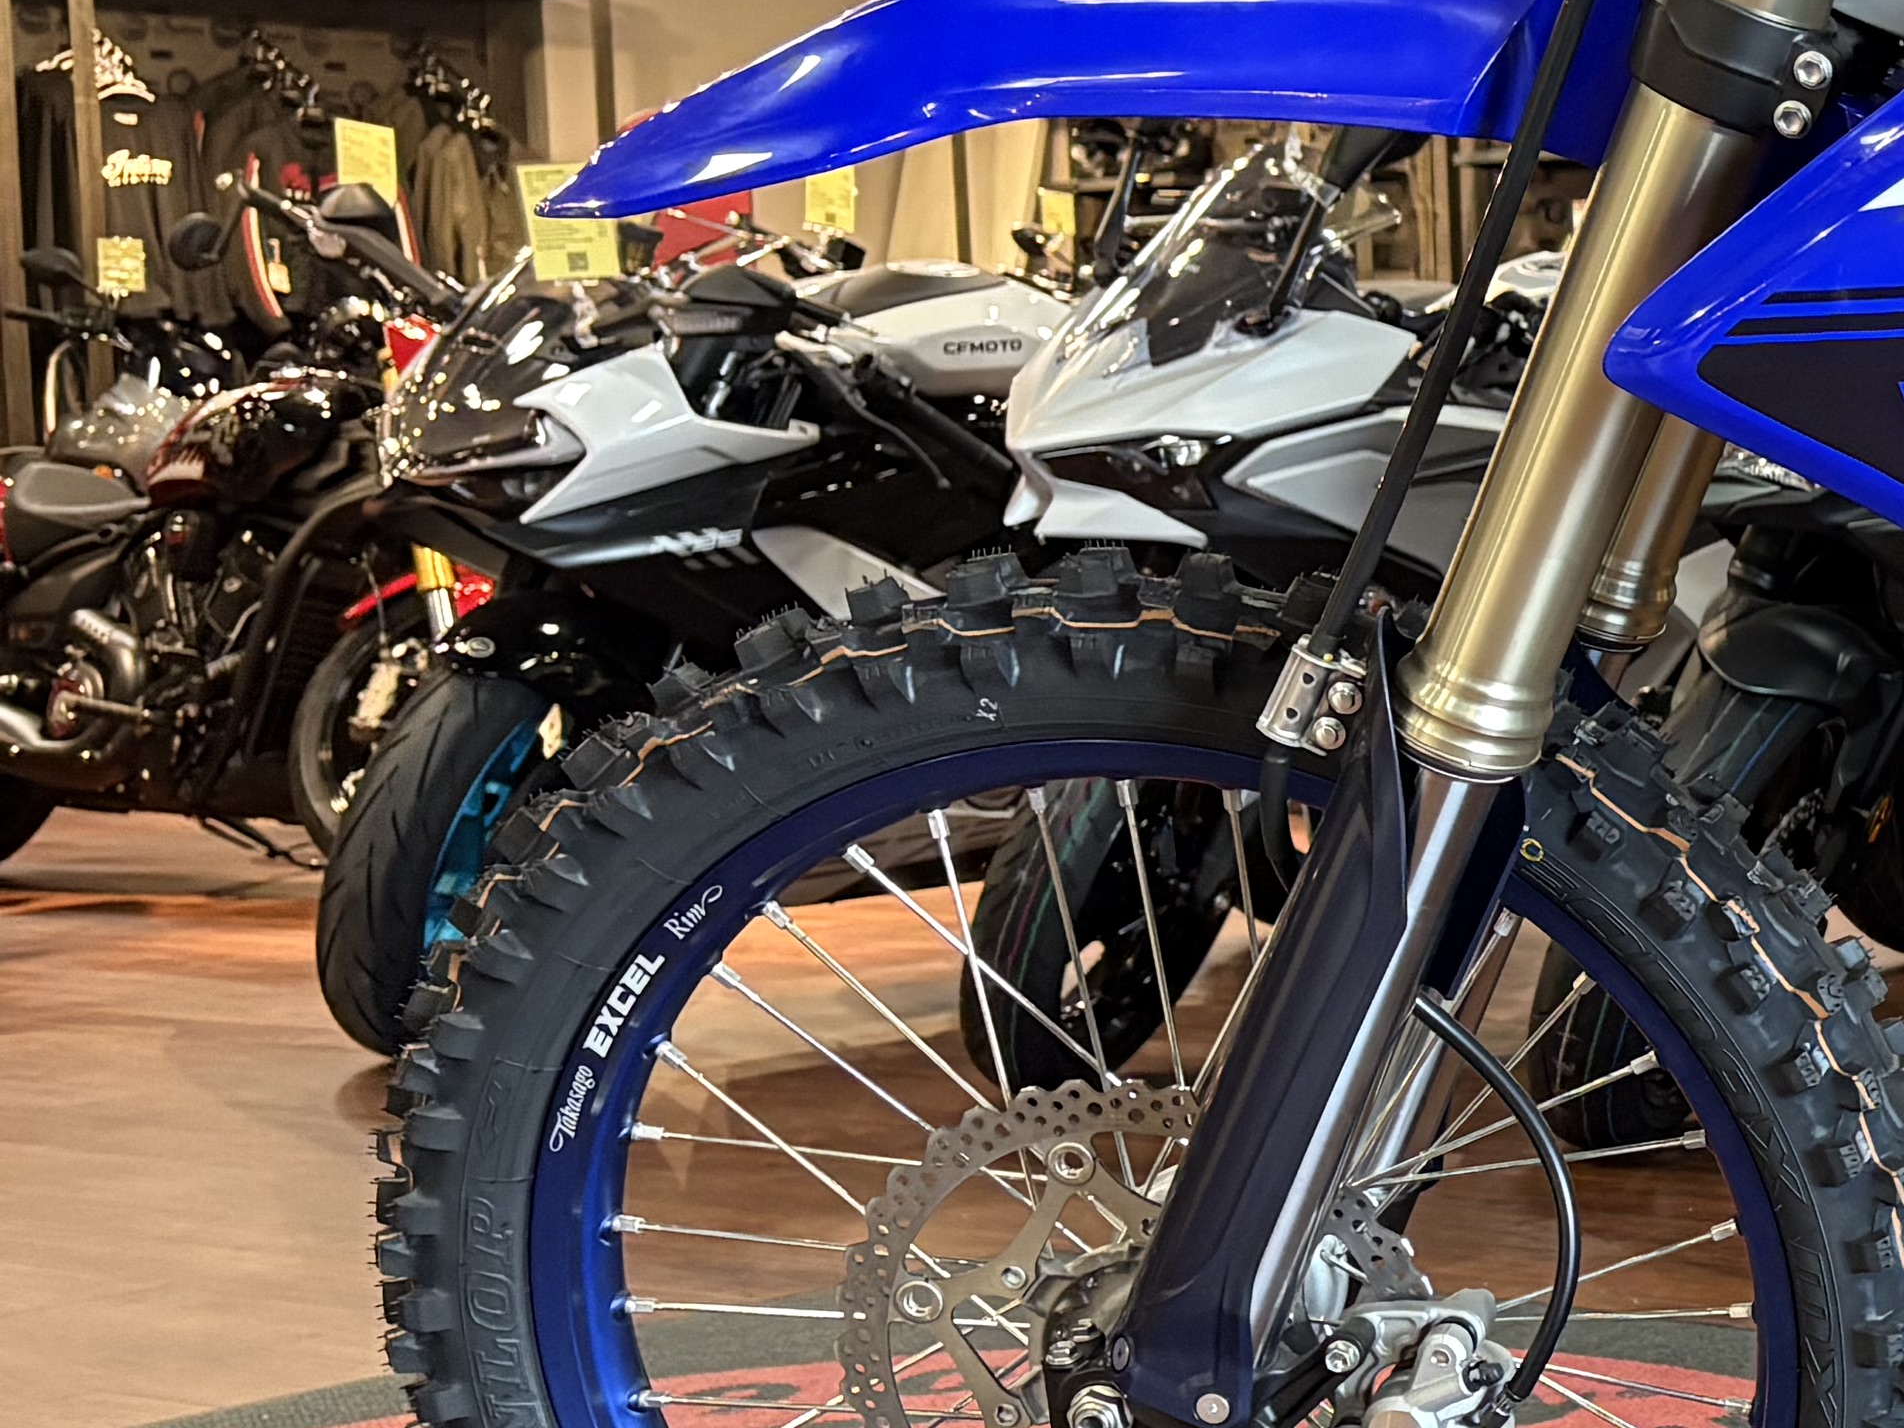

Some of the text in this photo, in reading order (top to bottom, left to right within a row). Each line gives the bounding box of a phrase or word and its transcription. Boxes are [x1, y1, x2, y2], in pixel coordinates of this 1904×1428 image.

[943, 338, 1023, 356] CFMOTO
[550, 884, 723, 1152] Takasago EXCEL Rim
